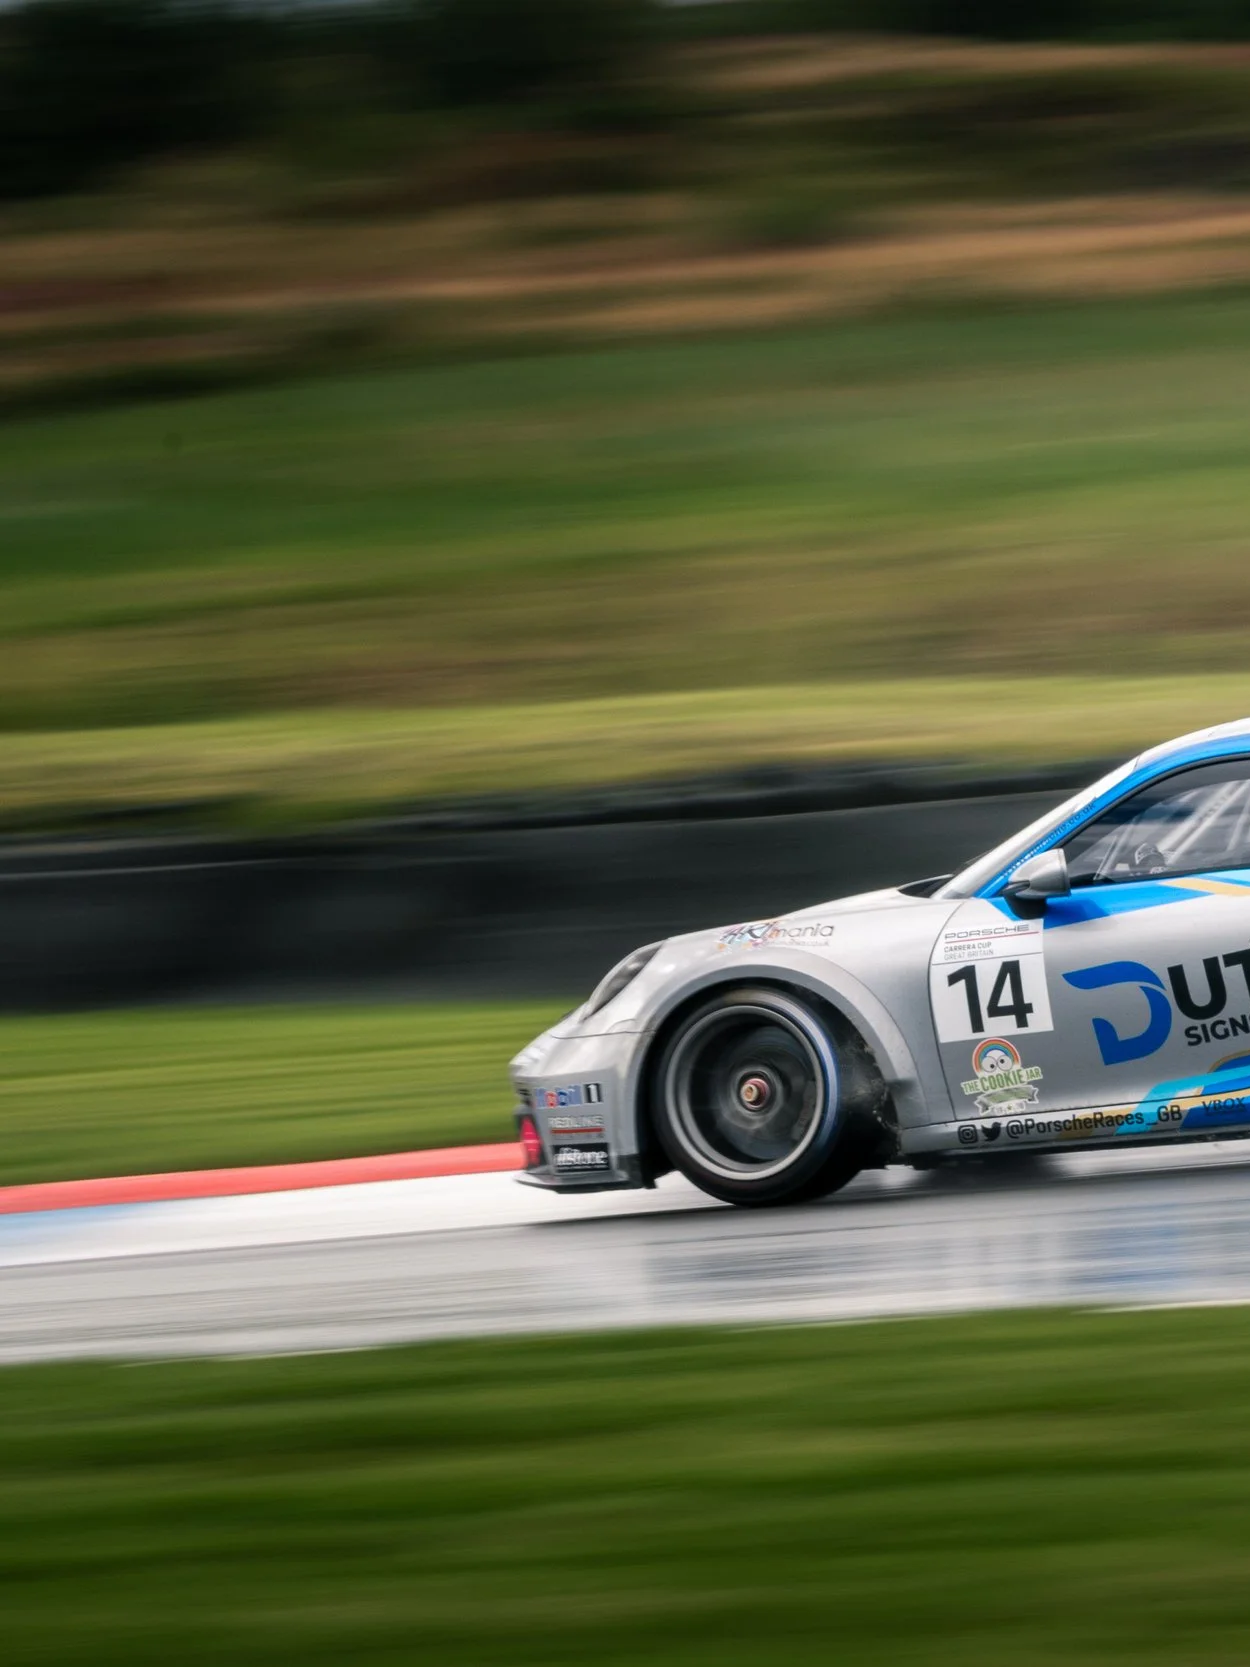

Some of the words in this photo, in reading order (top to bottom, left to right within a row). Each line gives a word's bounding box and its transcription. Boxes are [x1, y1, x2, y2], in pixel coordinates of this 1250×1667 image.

[944, 924, 1029, 940] PORSCHE
[944, 943, 976, 953] CARRERA
[944, 952, 967, 960] GREAT
[967, 950, 994, 958] BRITAIN
[947, 960, 1034, 1033] 14
[963, 1081, 980, 1093] THE
[980, 1069, 1025, 1091] COOKIE
[1026, 1068, 1042, 1080] JAR
[1202, 1097, 1246, 1112] VBOX
[1006, 1104, 1182, 1139] @PorscheRaces_GB
